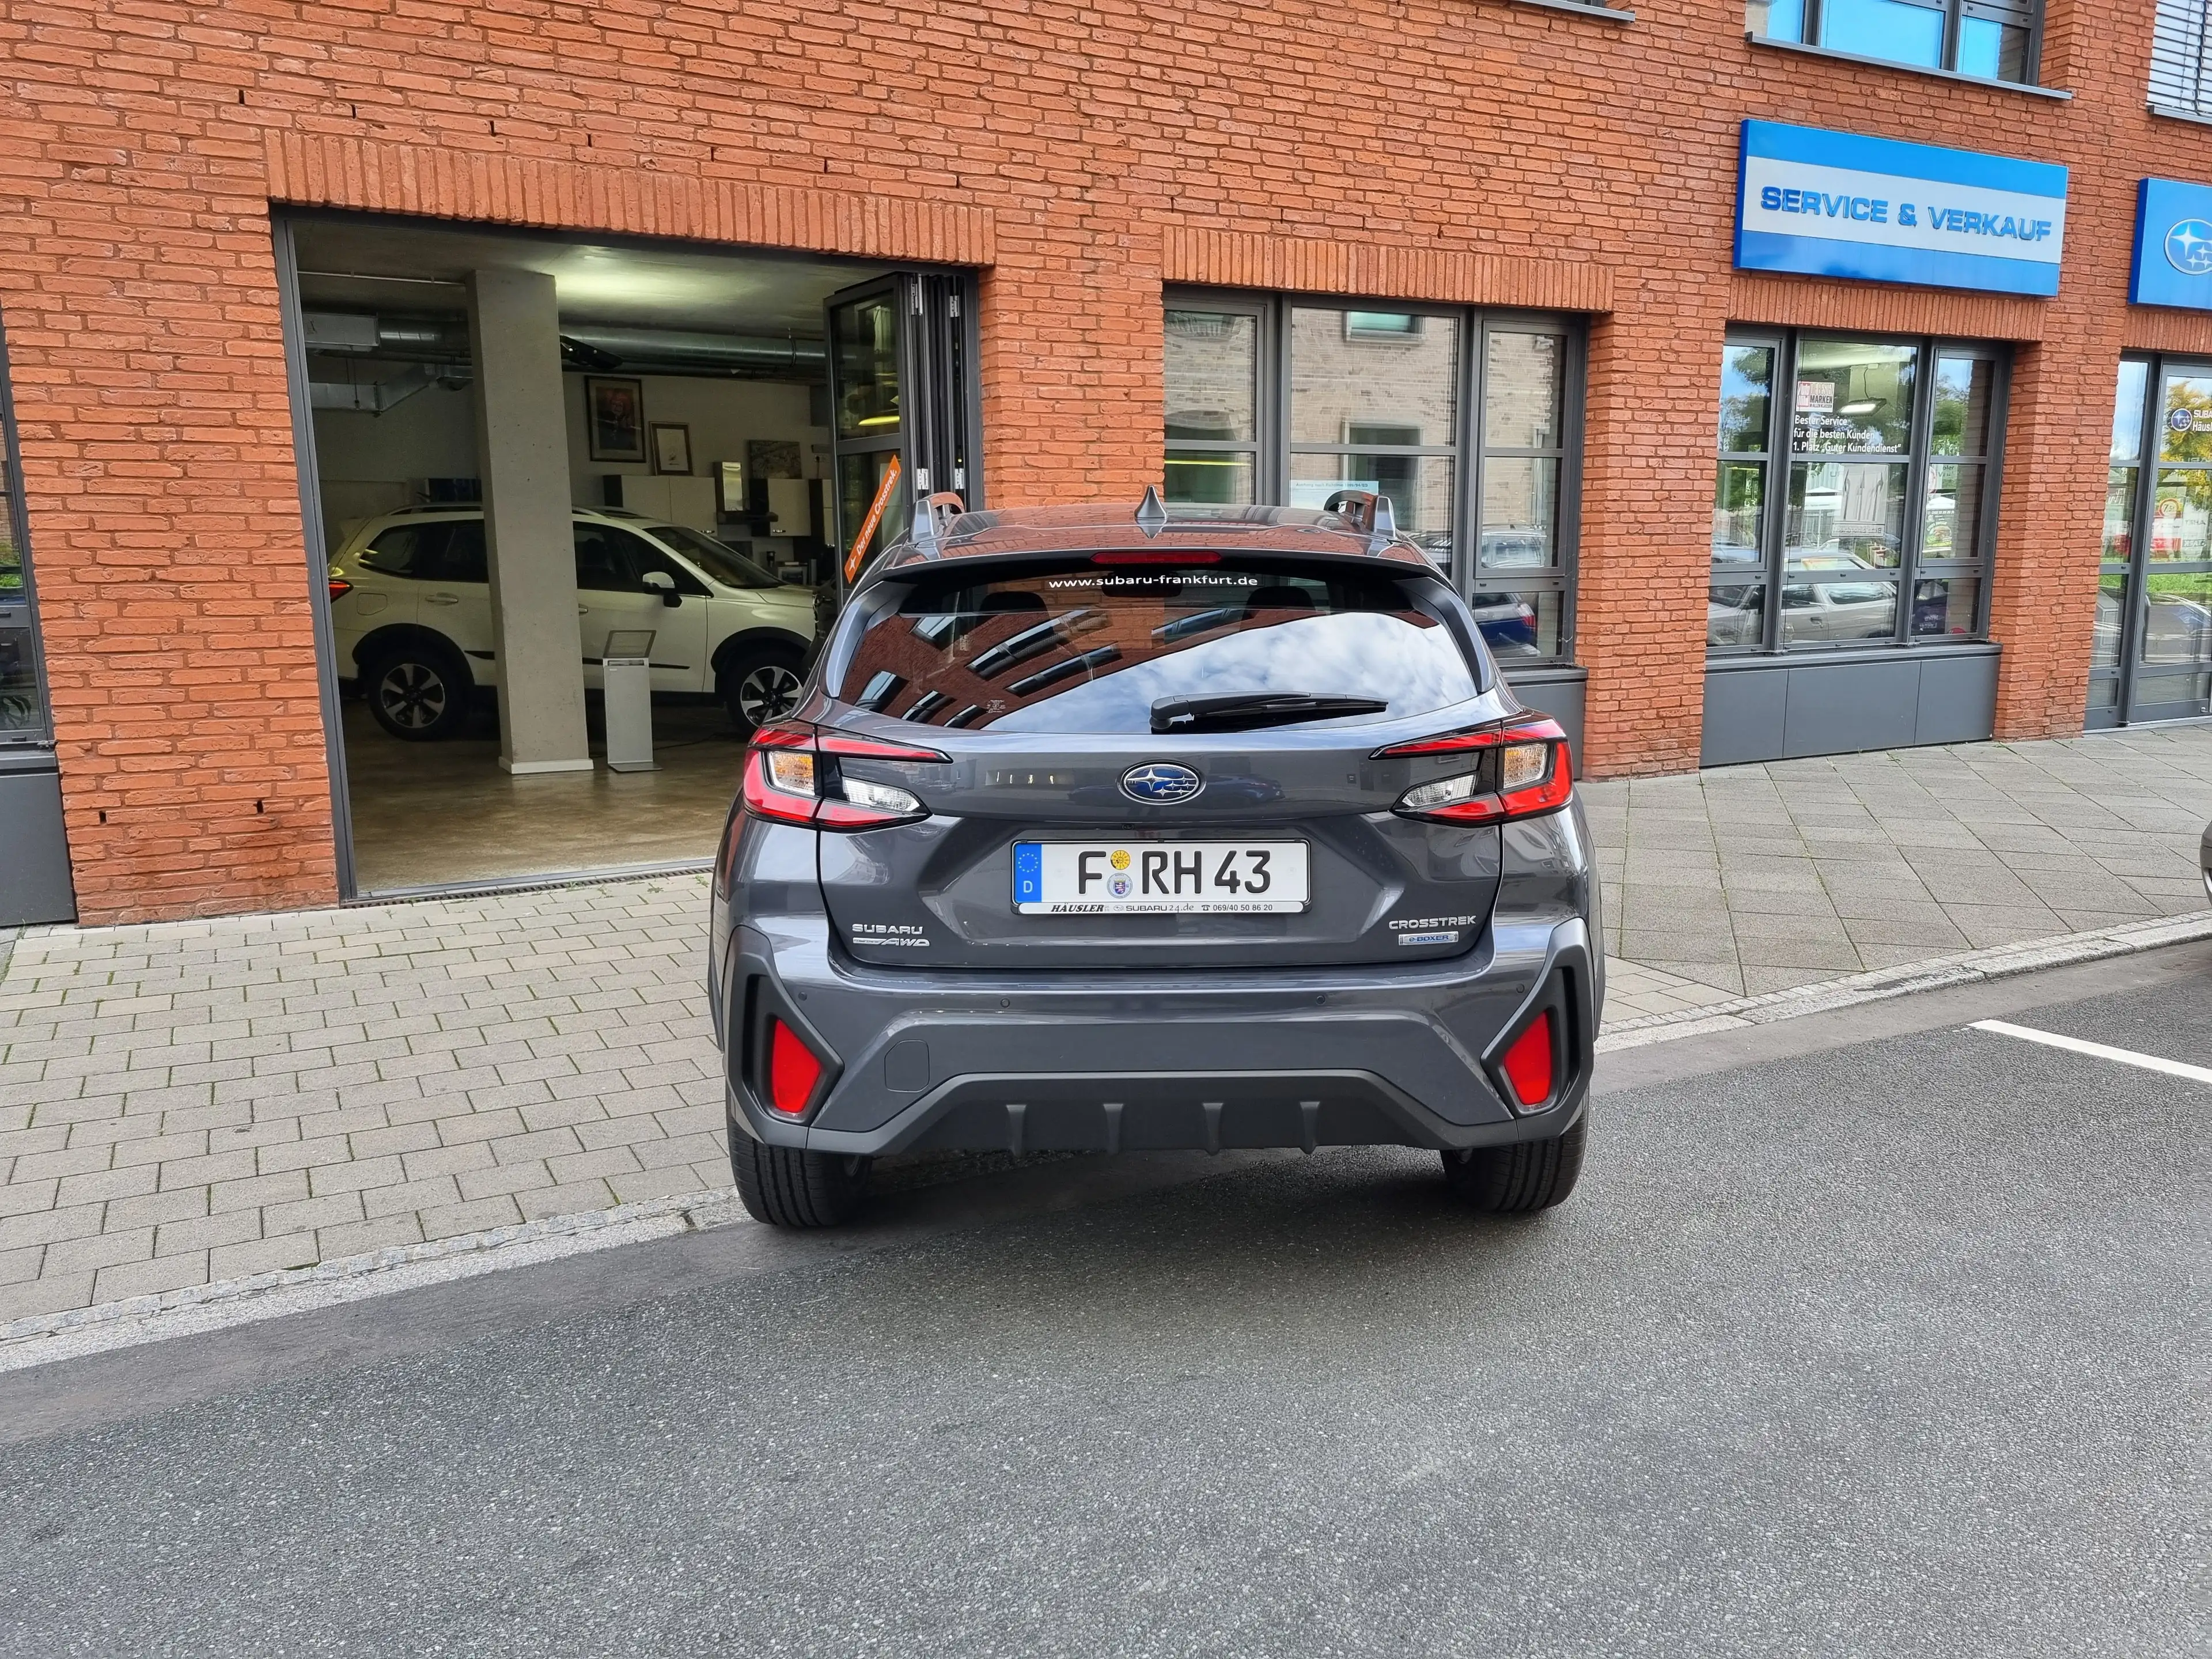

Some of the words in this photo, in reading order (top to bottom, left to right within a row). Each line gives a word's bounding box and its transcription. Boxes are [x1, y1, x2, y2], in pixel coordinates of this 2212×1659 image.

[1761, 185, 1888, 223] SERVICE
[1897, 203, 1918, 227] &
[1927, 206, 2052, 241] VERKAUF
[1809, 395, 1832, 403] MARKEN
[1794, 415, 1819, 425] Bester
[1820, 415, 1848, 426] Service
[1793, 427, 1805, 438] für
[1806, 429, 1819, 438] die
[1820, 429, 1845, 439] besten
[1846, 429, 1875, 440] Kunden
[1793, 441, 1800, 451] 1.
[1801, 442, 1820, 452] Platz
[857, 536, 866, 556] Der
[865, 514, 876, 540] neue
[1048, 575, 1258, 588] www.subaru-frankfurt.de
[1078, 851, 1107, 895] F
[1142, 850, 1202, 895] RH
[1214, 850, 1271, 894] 43
[1024, 880, 1033, 893] D
[1051, 902, 1104, 912] HÄUSLER
[852, 923, 923, 934] SUBARU
[1389, 915, 1476, 929] CROSSTREK
[881, 938, 930, 946] AWD
